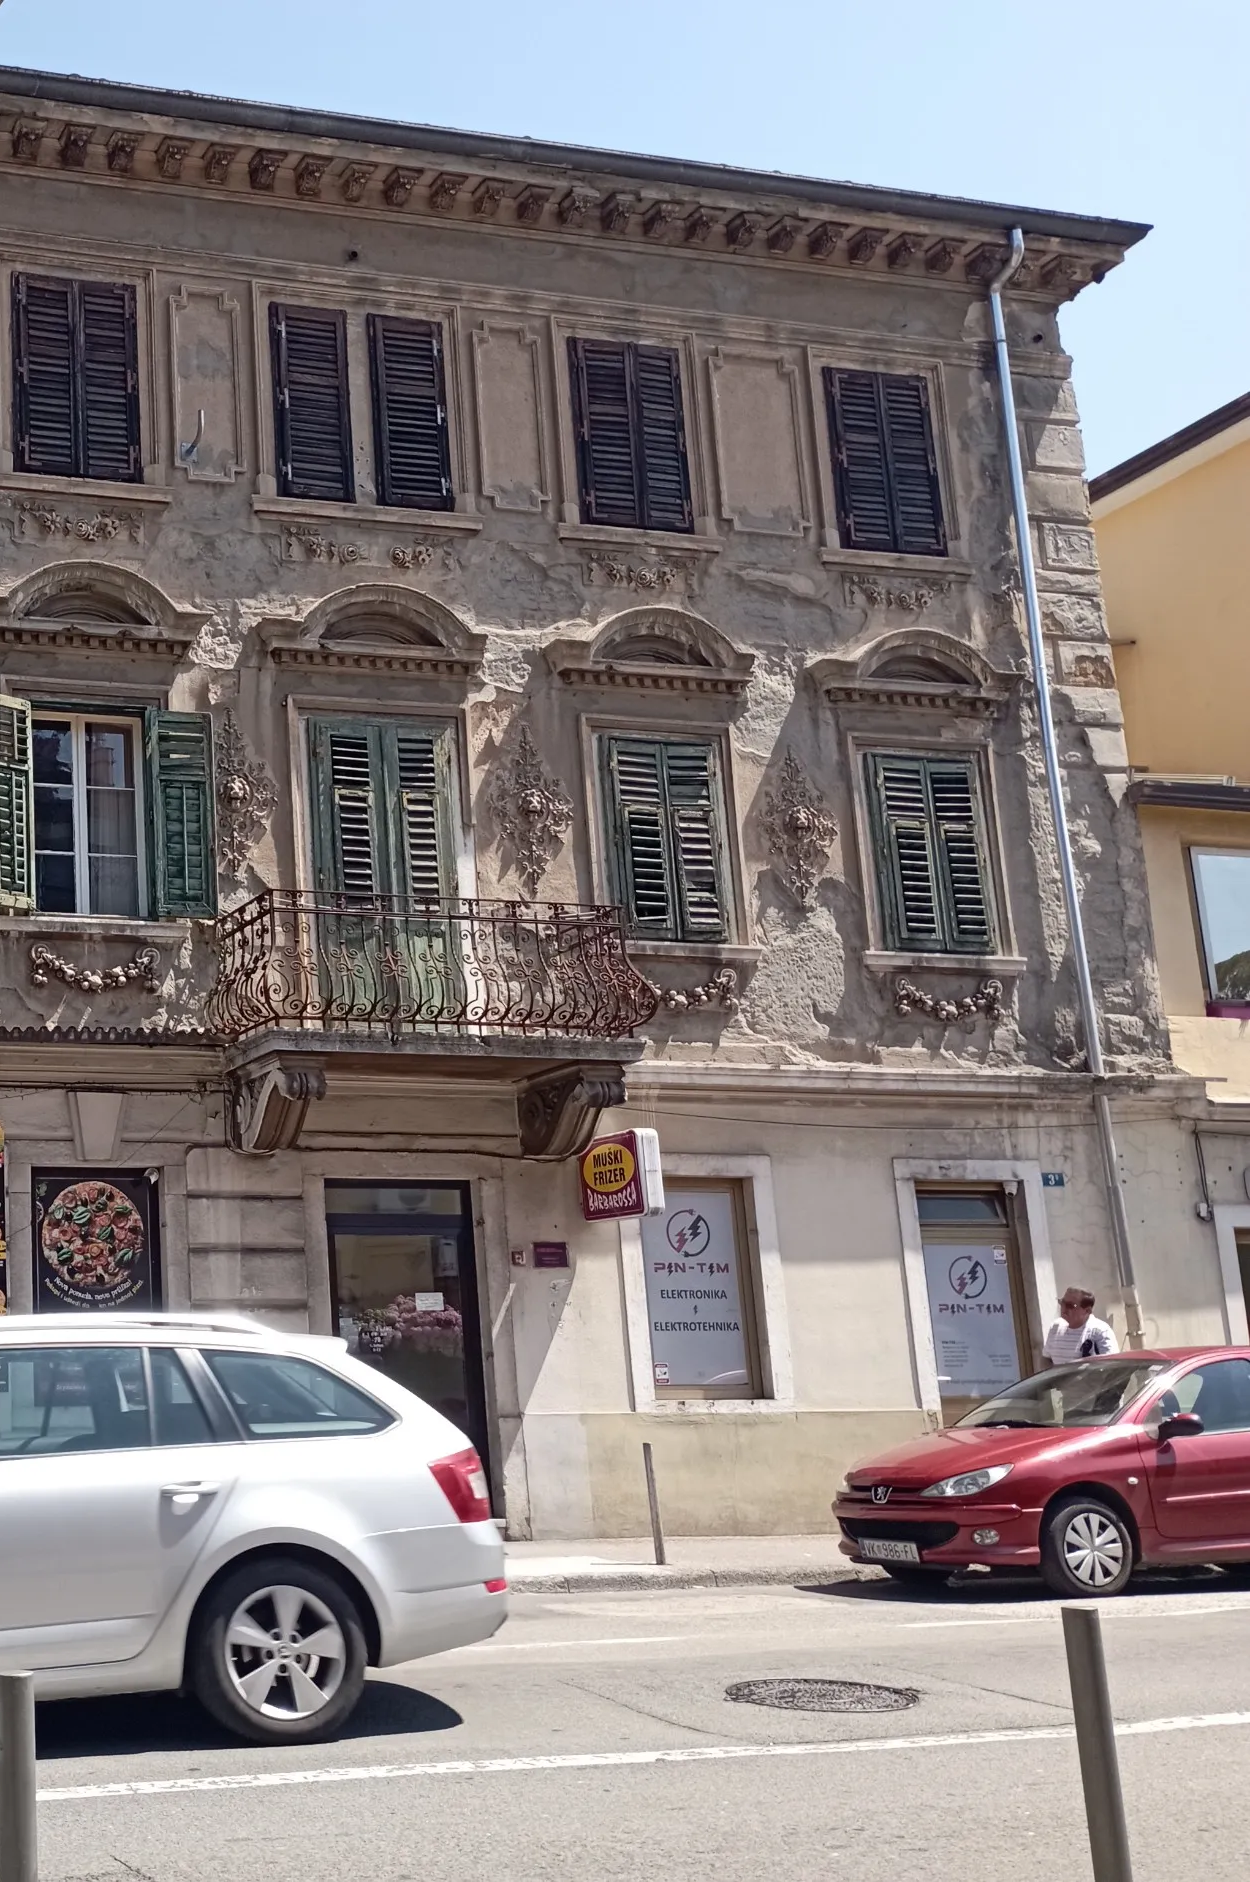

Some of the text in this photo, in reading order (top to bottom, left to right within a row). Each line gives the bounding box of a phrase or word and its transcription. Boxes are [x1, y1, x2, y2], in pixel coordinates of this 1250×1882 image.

[593, 1147, 623, 1169] MUŠKI
[593, 1168, 626, 1187] FRIZER
[587, 1181, 637, 1212] BARBAROSSA
[660, 1289, 728, 1300] ELEKTRONIKA
[653, 1321, 740, 1332] ELEKTROTEHNIKA
